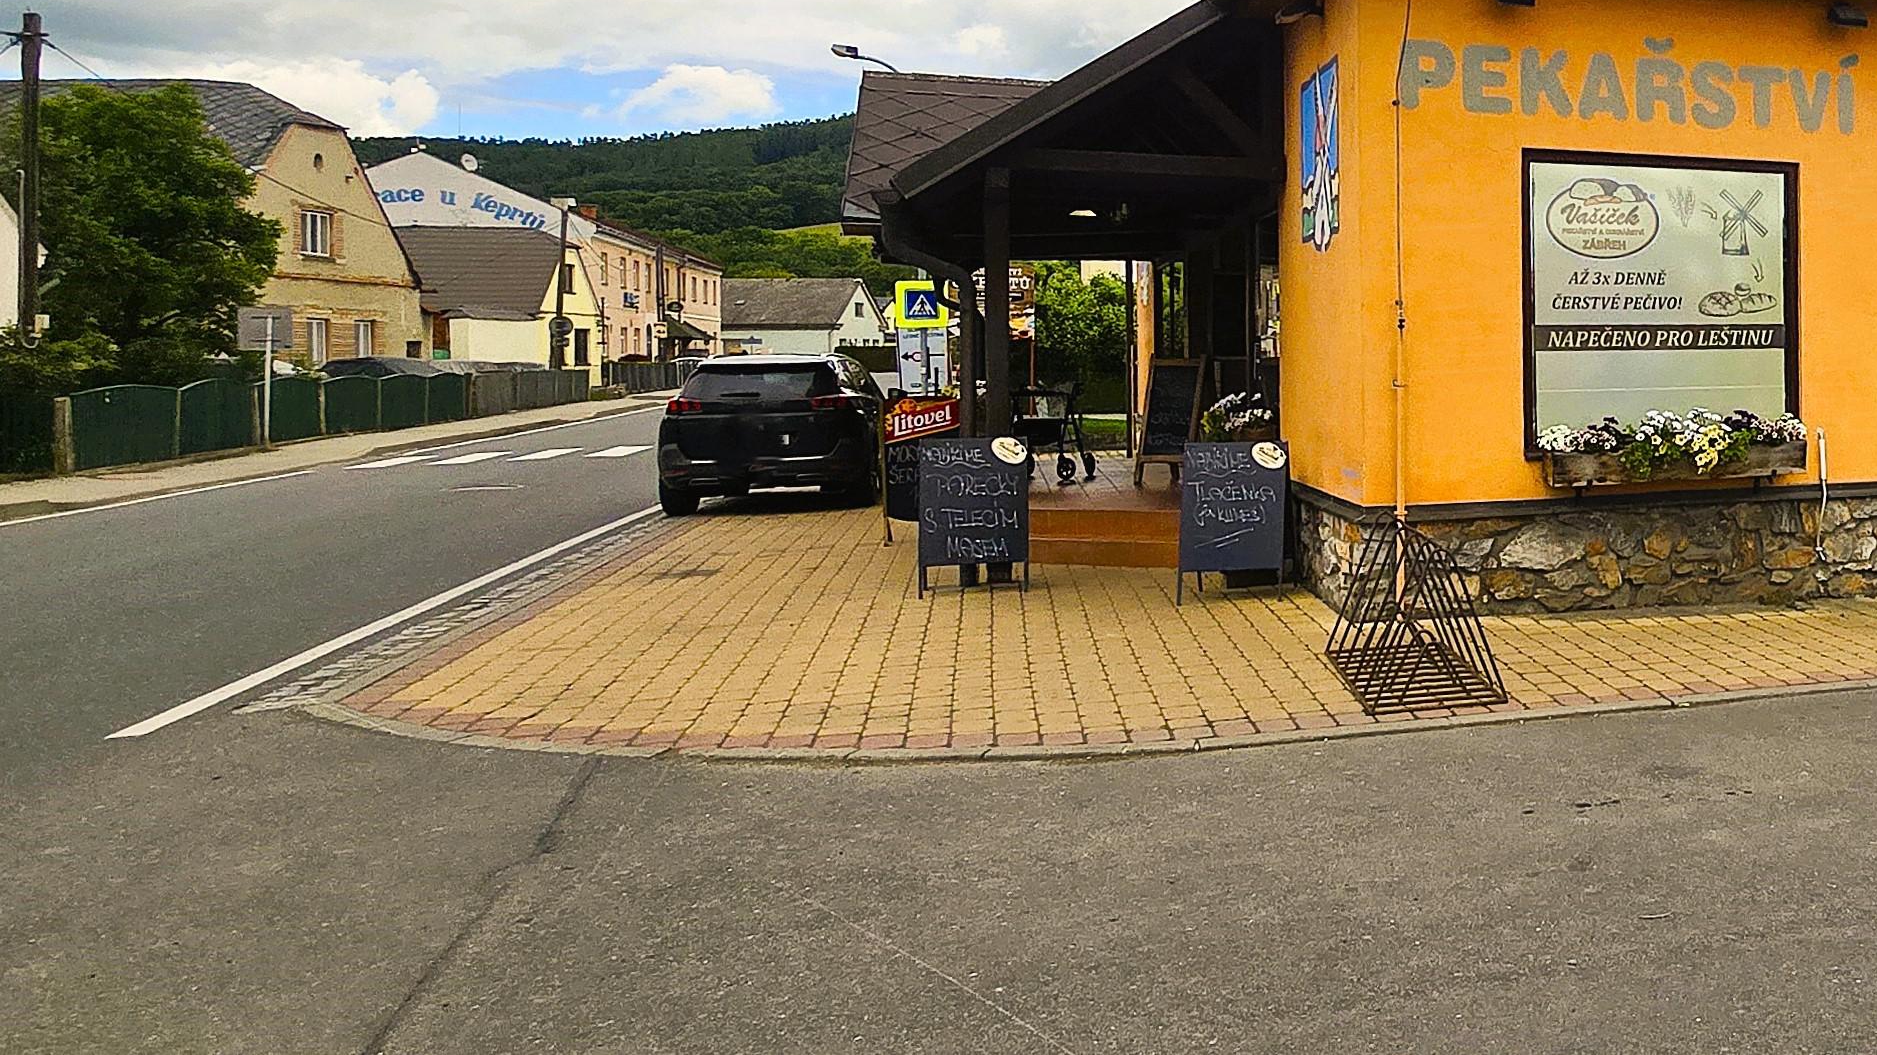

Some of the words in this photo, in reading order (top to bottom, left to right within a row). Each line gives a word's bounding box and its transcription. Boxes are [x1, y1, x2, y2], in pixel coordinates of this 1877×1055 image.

[1400, 36, 1860, 135] PEKAŘSTVÍ
[376, 188, 424, 204] ace
[440, 190, 456, 206] u
[1560, 203, 1640, 226] Vašíček
[1582, 237, 1627, 251] ZÁBŘEH
[1568, 269, 1590, 285] AŽ
[1592, 272, 1611, 285] 3x
[1614, 270, 1667, 285] DENNĚ
[1551, 293, 1620, 310] ČERSTVÉ
[1623, 294, 1683, 310] PEČIVO!
[1548, 327, 1651, 347] NAPEČENO
[1654, 330, 1694, 347] PRO
[1697, 326, 1774, 346] LEŠTINU
[893, 405, 952, 436] Litovel
